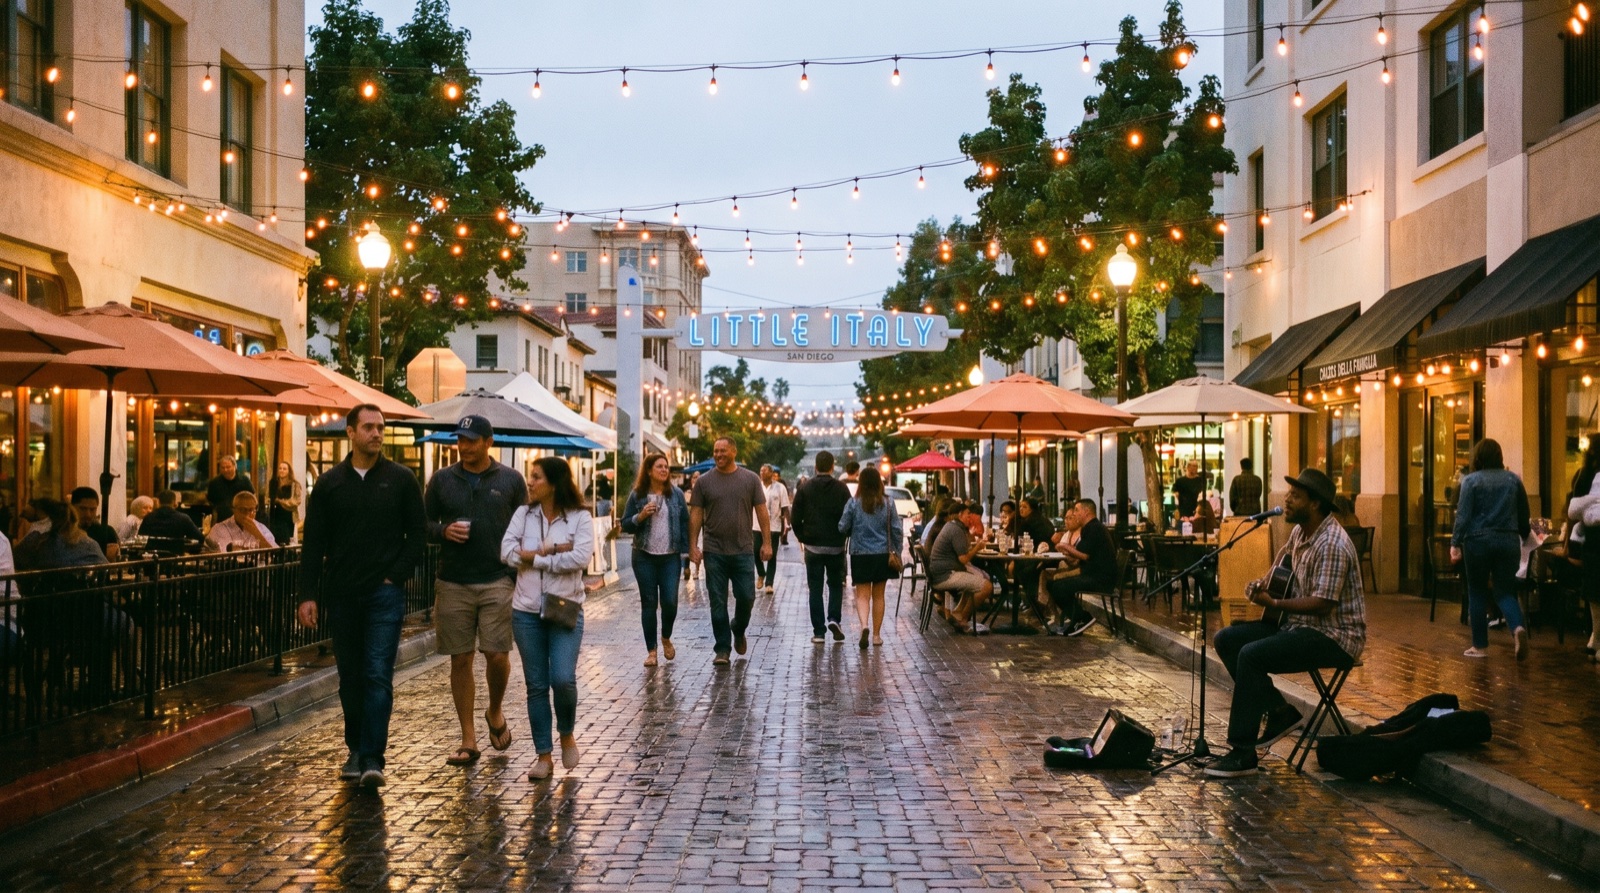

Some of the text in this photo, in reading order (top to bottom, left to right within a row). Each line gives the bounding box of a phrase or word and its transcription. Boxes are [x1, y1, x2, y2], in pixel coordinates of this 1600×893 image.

[690, 314, 935, 346] LITTLE ITALY
[787, 352, 804, 360] SAN
[1337, 361, 1352, 376] DELLA
